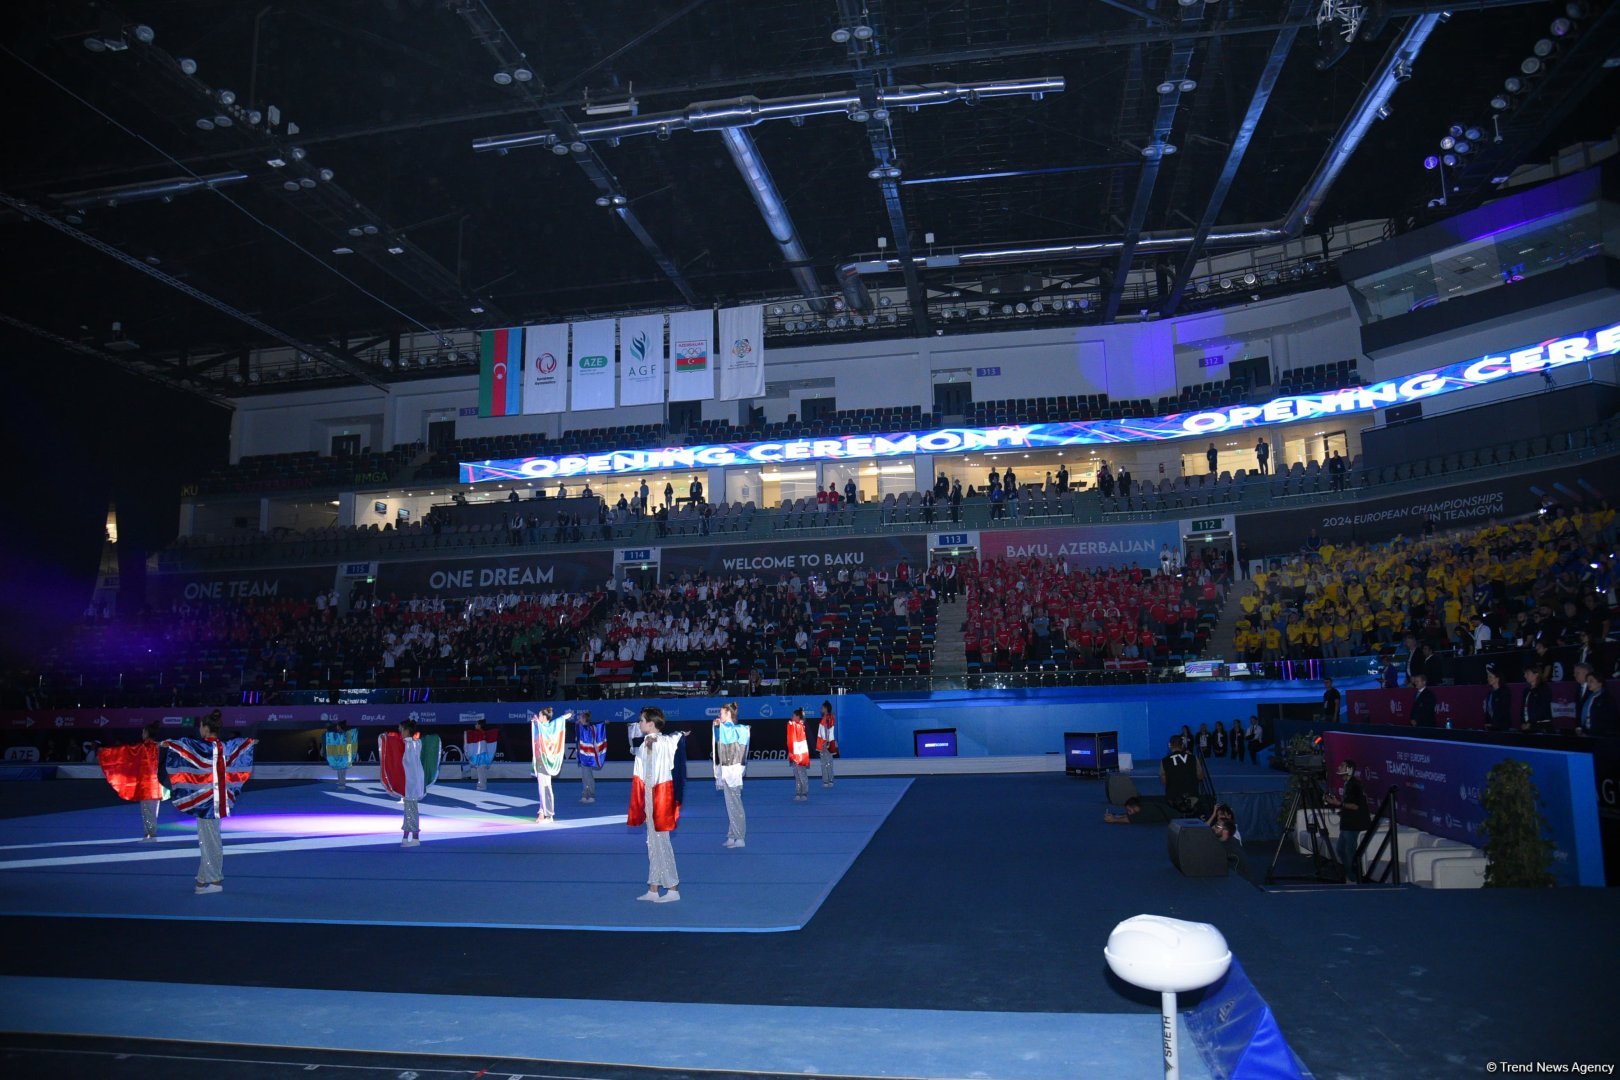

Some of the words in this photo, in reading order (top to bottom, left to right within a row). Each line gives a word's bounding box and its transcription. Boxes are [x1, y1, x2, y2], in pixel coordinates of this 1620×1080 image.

[583, 358, 602, 367] AZE
[1205, 357, 1218, 367] 312
[982, 368, 996, 377] 313
[1182, 373, 1447, 432] OPENING
[521, 447, 738, 476] OPENING
[749, 427, 1034, 461] CEREMONY
[1322, 516, 1351, 528] 2024
[1353, 506, 1409, 525] EUROPEAN
[1411, 492, 1504, 516] CHAMPIONSHIPS
[1430, 513, 1441, 522] IN
[1444, 504, 1504, 520] TEAMGYM
[1198, 520, 1215, 530] 112
[945, 535, 961, 545] 113
[629, 551, 644, 560] 114
[1006, 545, 1053, 559] BAKU,
[1059, 539, 1156, 557] AZERBAIJAN
[352, 565, 365, 574] 115
[722, 554, 795, 571] WELCOME
[800, 553, 820, 567] TO
[825, 552, 864, 566] BAKU
[429, 569, 474, 589] ONE
[480, 565, 555, 587] DREAM
[184, 581, 223, 600] ONE
[228, 579, 278, 597] TEAM
[1170, 753, 1188, 767] TV
[1385, 760, 1415, 777] TEAMGYM
[1163, 1015, 1173, 1057] SPIETH
